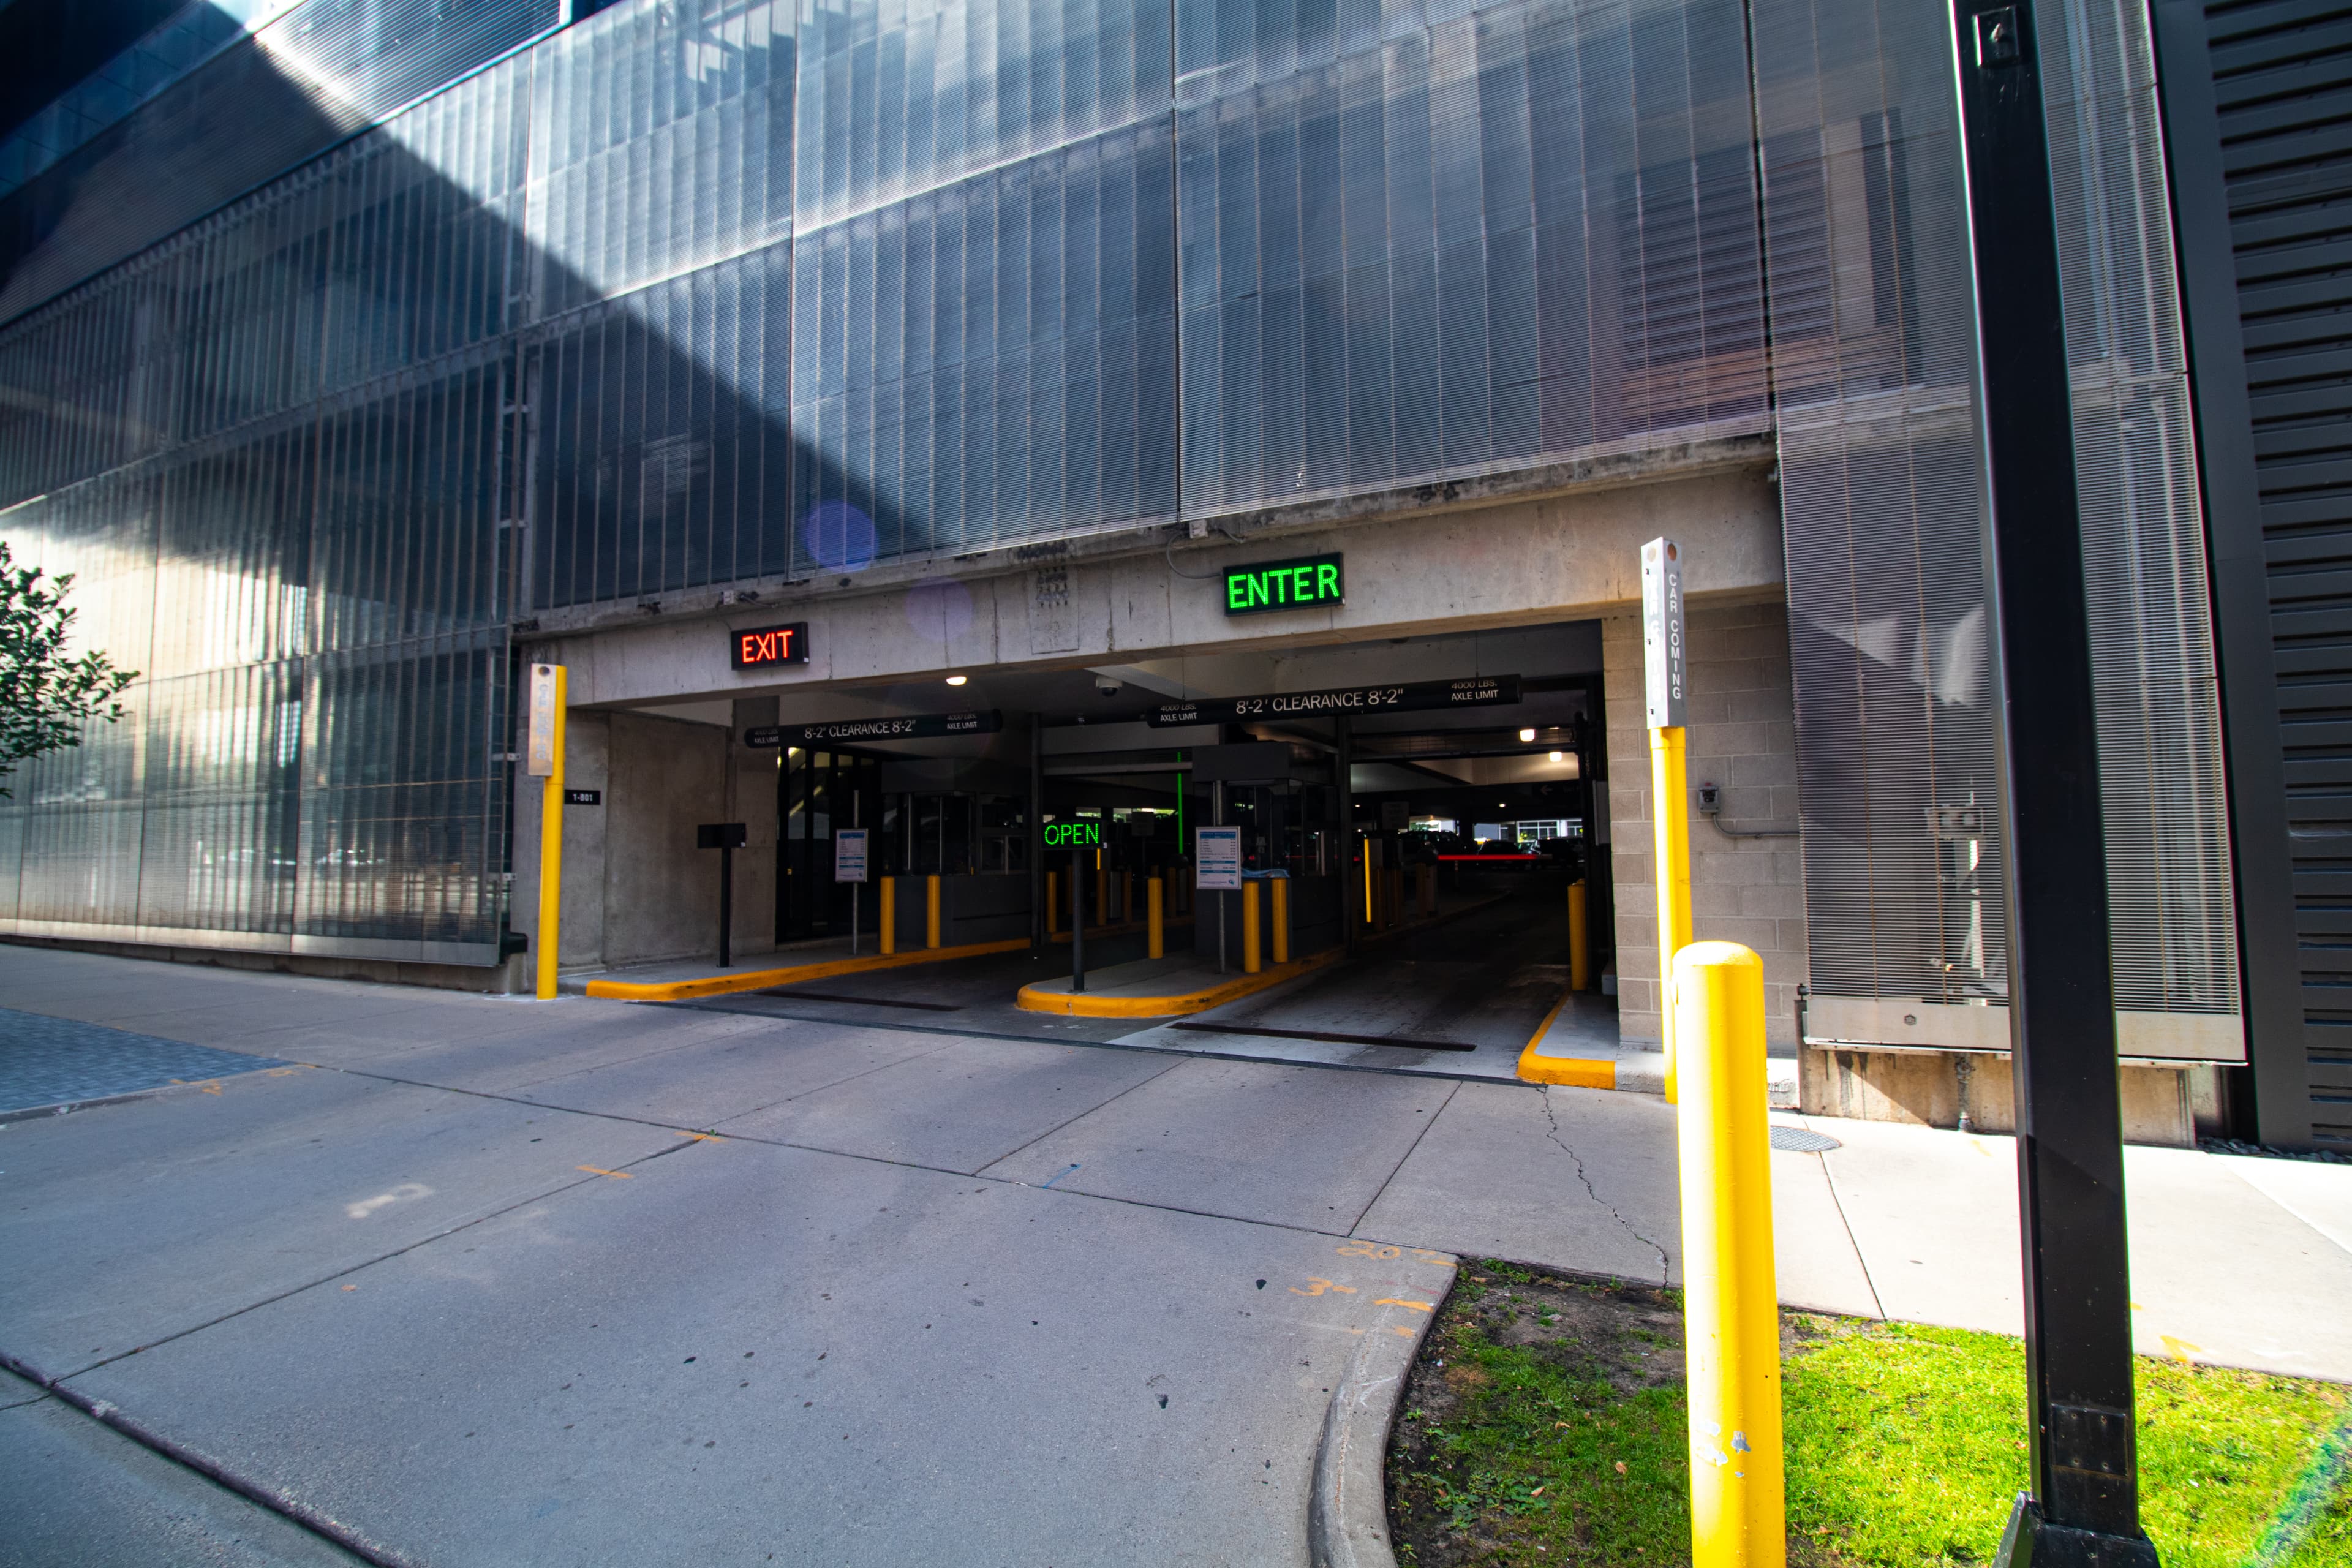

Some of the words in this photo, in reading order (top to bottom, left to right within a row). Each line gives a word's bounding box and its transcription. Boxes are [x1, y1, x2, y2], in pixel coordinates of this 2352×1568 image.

[1229, 564, 1340, 608] ENTER
[1668, 574, 1678, 614] CAR
[742, 630, 793, 663] EXIT
[1670, 620, 1681, 699] COMING
[1451, 680, 1476, 689] 4000
[1451, 692, 1473, 701] AXLE
[1475, 689, 1499, 699] LIMIT
[1272, 692, 1363, 712] CLEARANCE
[1368, 688, 1404, 705] 8'-2"
[1178, 712, 1197, 721] LIMIT
[829, 723, 890, 737] CLEARANCE
[892, 720, 916, 733] 8'-2"
[1044, 823, 1099, 845] OPEN
